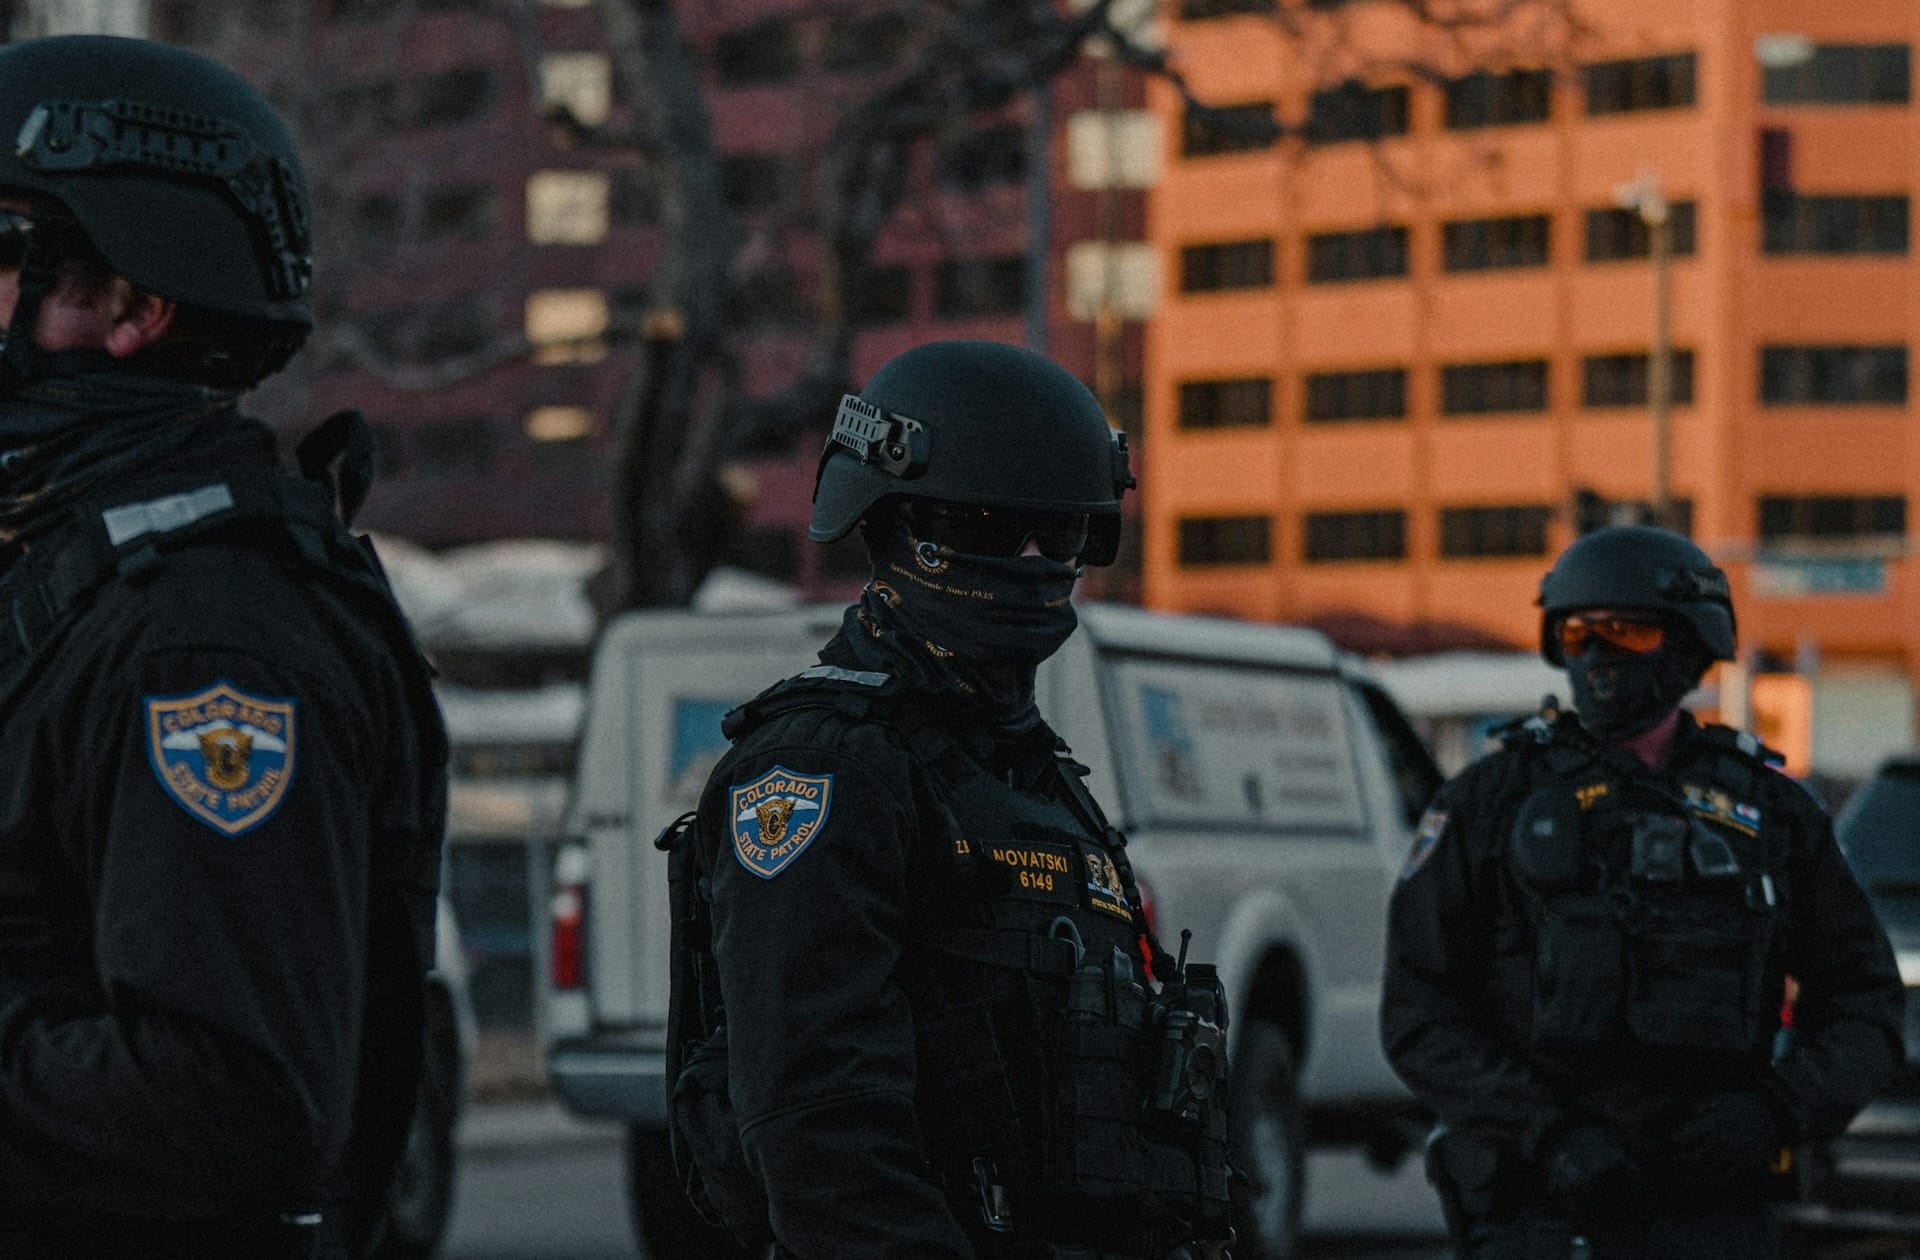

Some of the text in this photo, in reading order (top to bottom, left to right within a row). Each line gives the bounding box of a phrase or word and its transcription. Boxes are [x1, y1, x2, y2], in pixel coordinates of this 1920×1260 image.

[945, 585, 968, 597] Since
[971, 589, 995, 601] 1935
[163, 701, 282, 735] COLORADO
[739, 780, 818, 810] COLORADO
[739, 820, 815, 860] STATE PATROL
[1020, 871, 1053, 891] 6149
